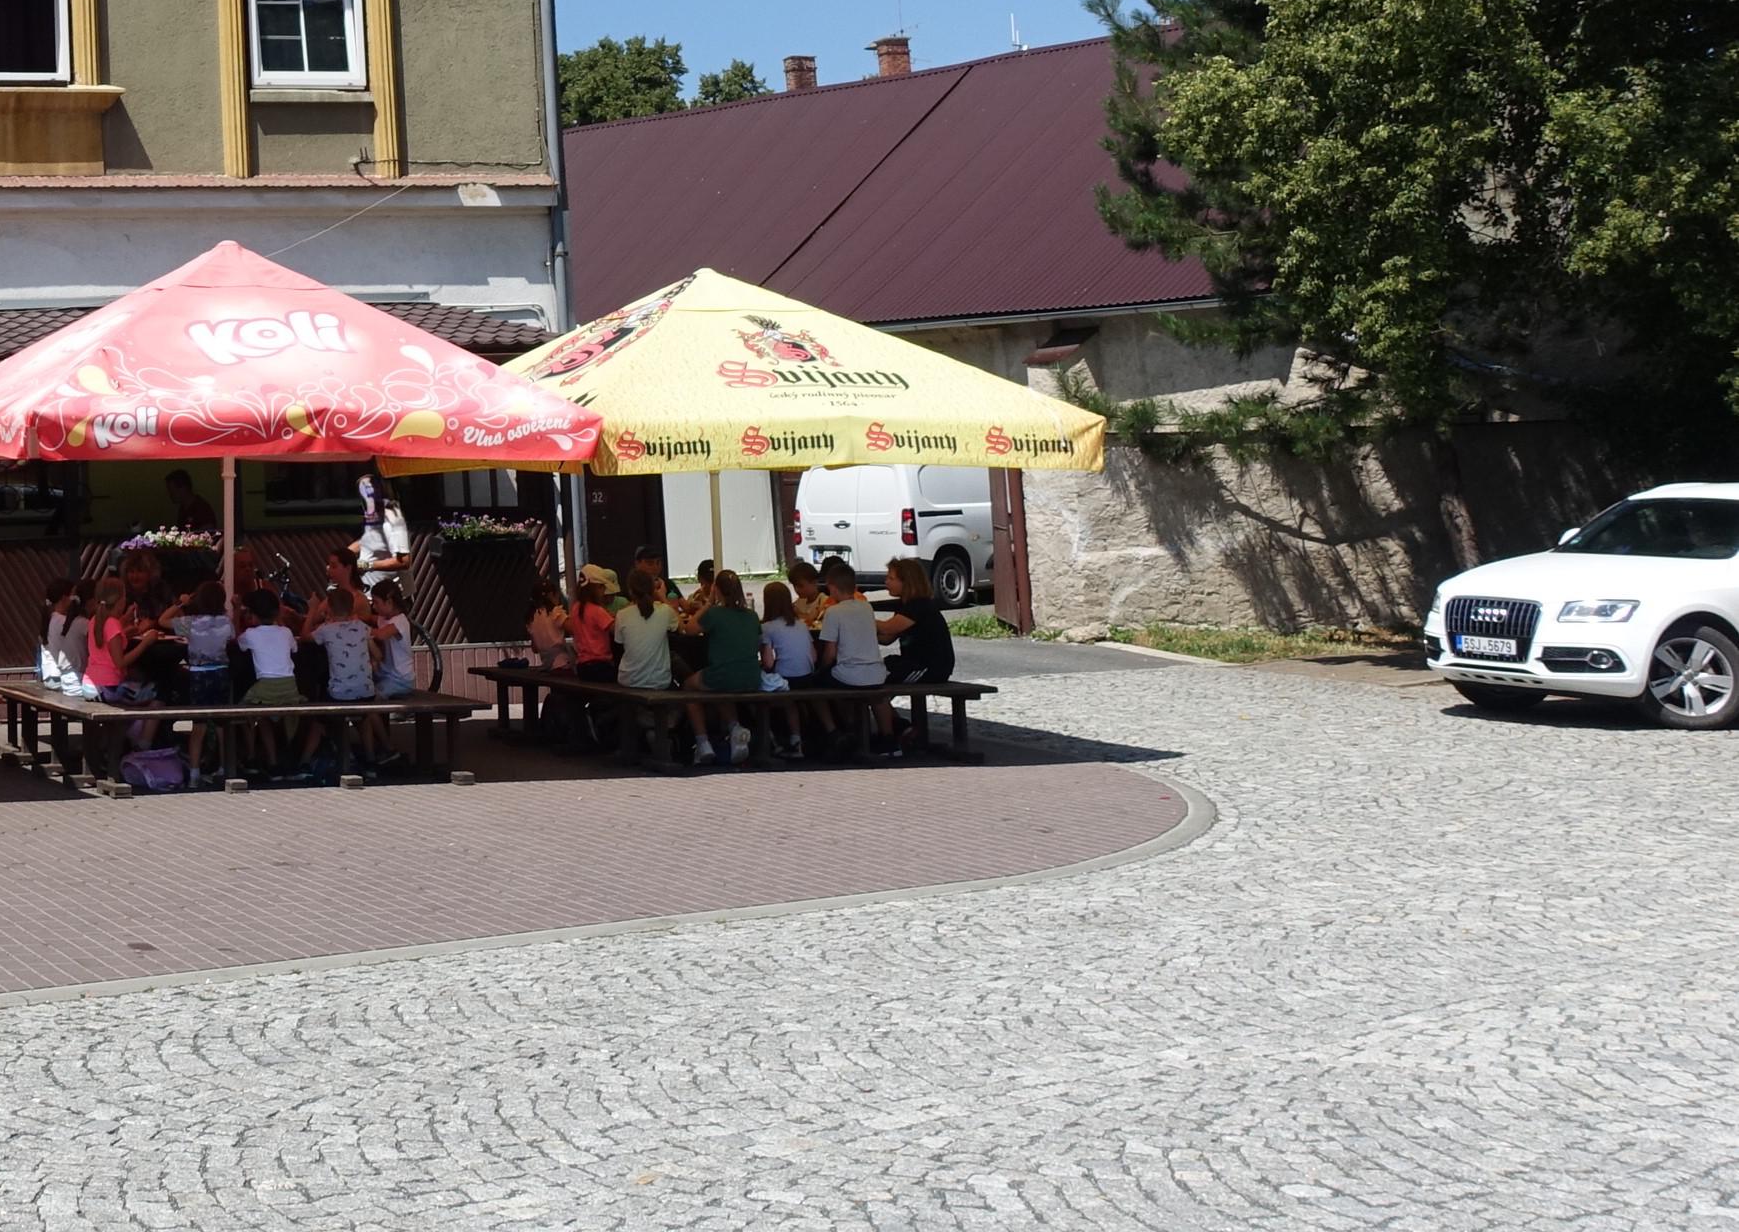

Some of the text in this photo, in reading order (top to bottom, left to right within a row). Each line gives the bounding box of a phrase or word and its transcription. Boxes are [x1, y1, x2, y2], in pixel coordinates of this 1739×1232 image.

[716, 360, 910, 390] Svijany
[92, 406, 159, 449] Koli
[463, 426, 505, 447] Vlna
[741, 425, 835, 457] Svijany
[865, 422, 957, 454] Svijany
[985, 425, 1075, 457] Svijany
[615, 430, 711, 461] Svijany
[592, 491, 604, 503] 32
[1464, 637, 1512, 653] 5SJ 5679
